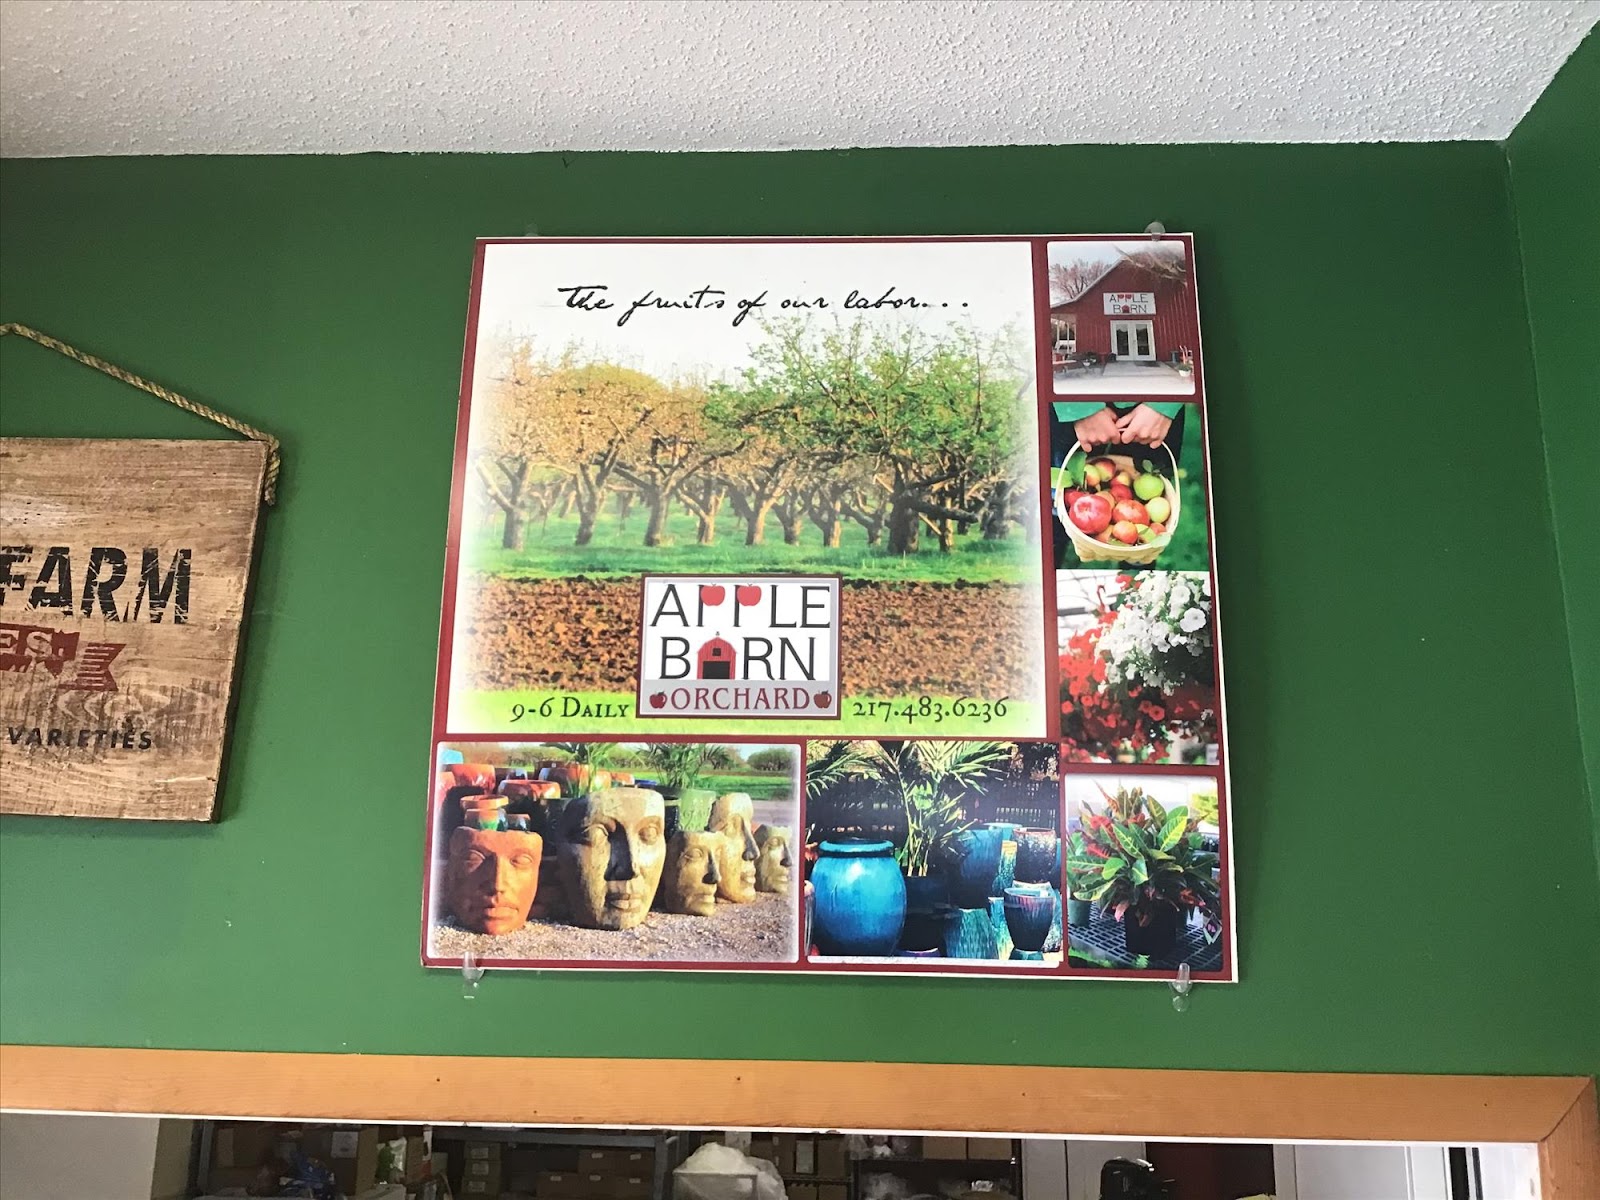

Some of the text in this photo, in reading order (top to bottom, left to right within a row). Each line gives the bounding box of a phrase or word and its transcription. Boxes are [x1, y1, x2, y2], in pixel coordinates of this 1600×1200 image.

[557, 285, 614, 311] The
[616, 285, 725, 327] fruits
[732, 290, 768, 327] of
[780, 296, 829, 309] our
[1109, 293, 1149, 303] APPLE
[0, 546, 192, 624] FARM
[649, 583, 831, 629] APPLE
[509, 696, 556, 723] 9-6
[671, 687, 811, 710] ORCHARD
[852, 695, 1010, 725] 217.483.6236
[7, 726, 153, 750] VARIETIES
